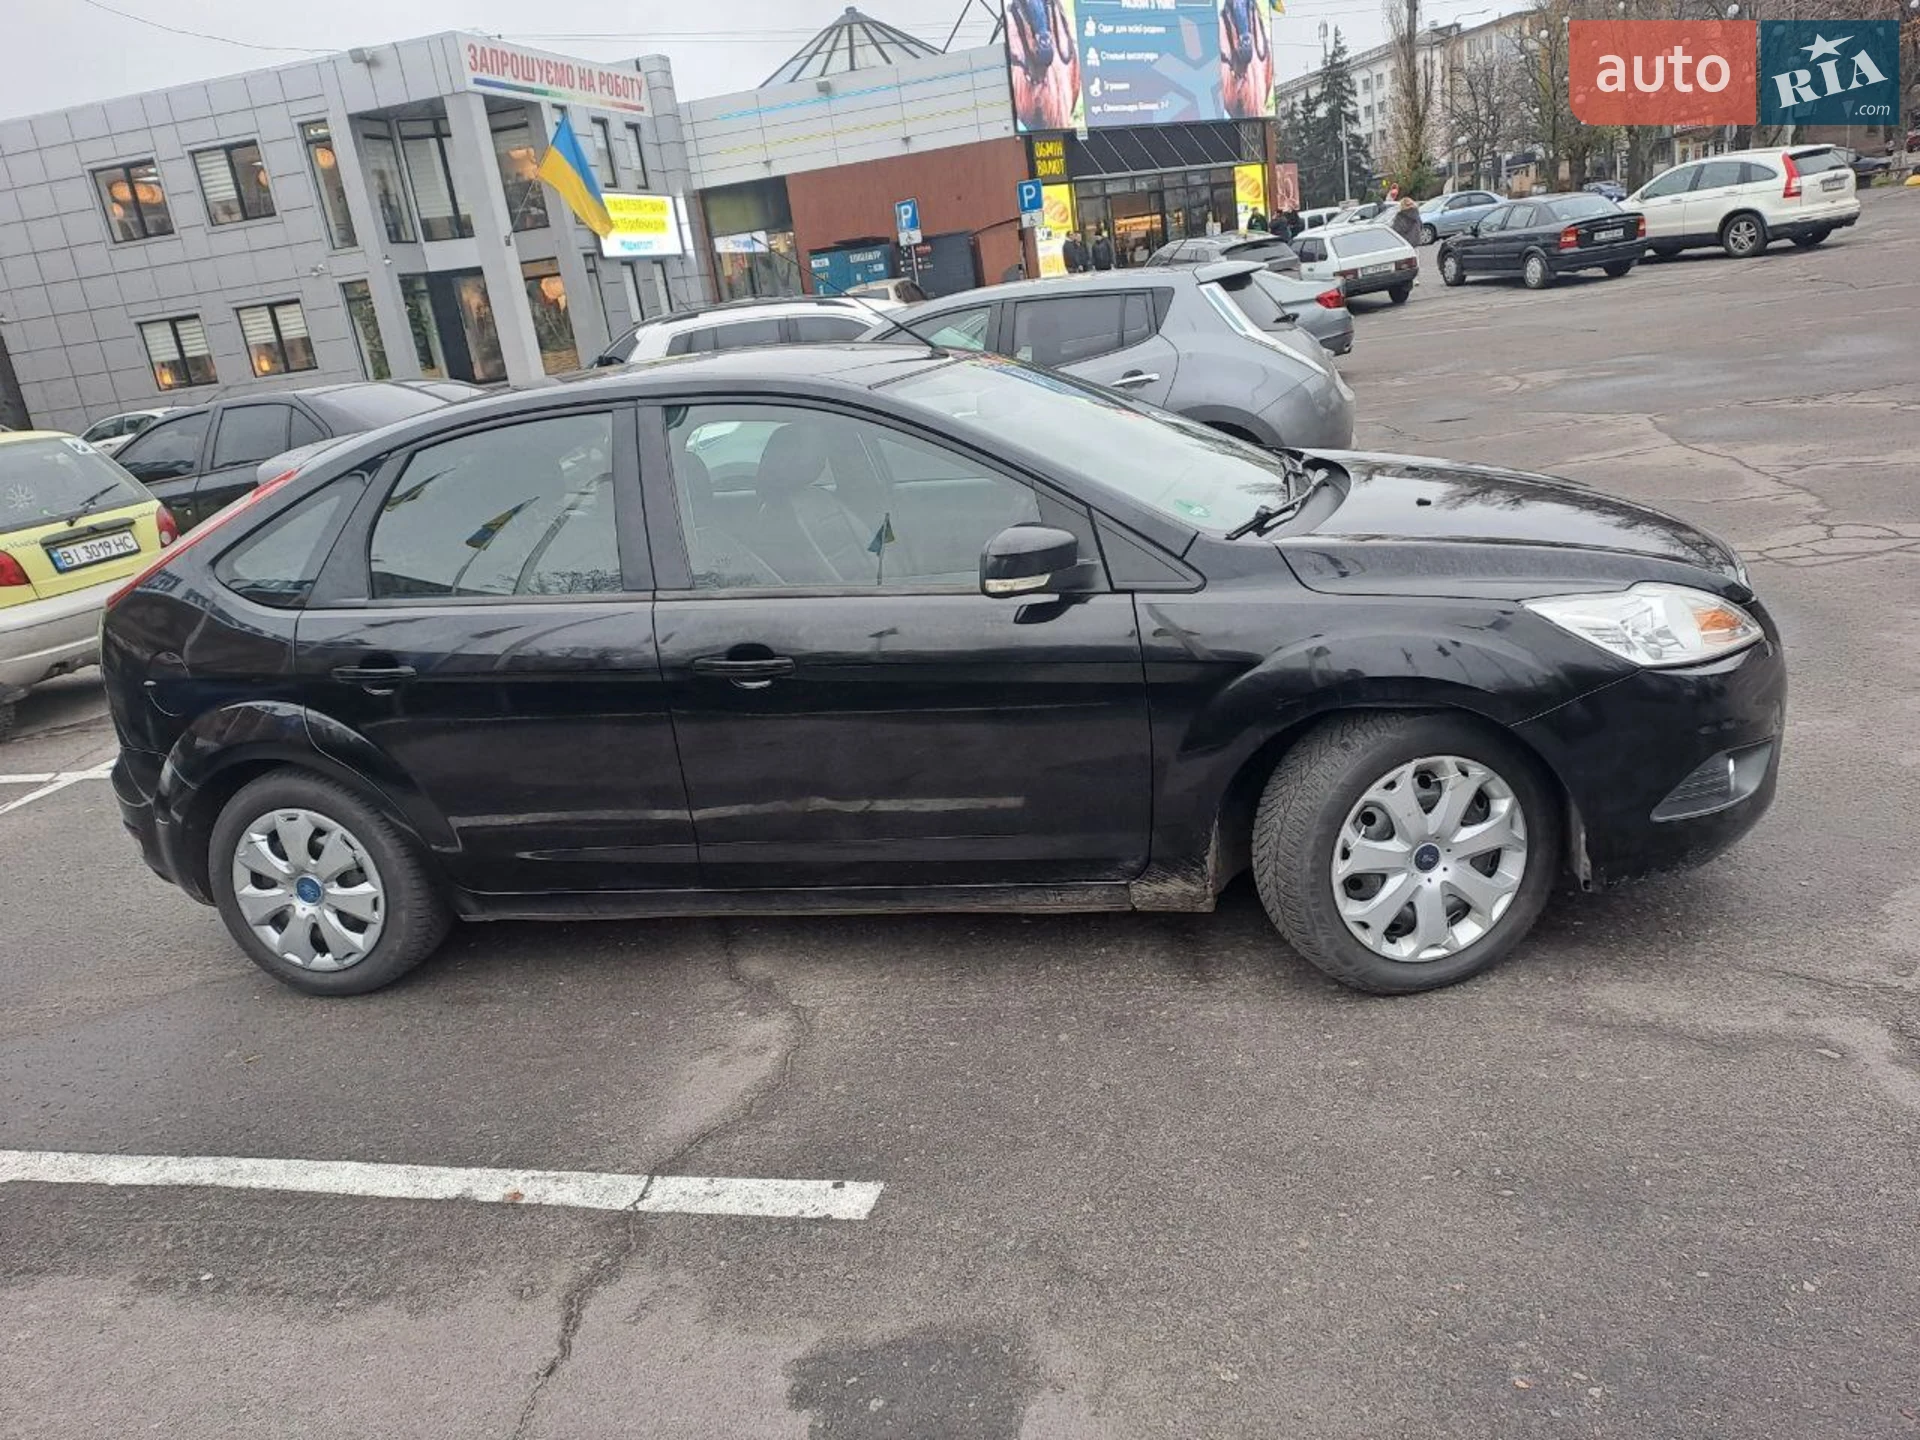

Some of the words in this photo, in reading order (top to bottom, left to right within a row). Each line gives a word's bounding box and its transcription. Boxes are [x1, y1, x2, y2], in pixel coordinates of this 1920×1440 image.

[467, 43, 575, 89] ЗАПРОШУЄМО
[578, 66, 596, 94] НА
[598, 72, 644, 101] РОБОТУ
[1022, 184, 1036, 208] P
[900, 204, 913, 228] P
[60, 548, 82, 565] BI
[82, 540, 112, 560] 3019
[112, 535, 134, 552] HC
